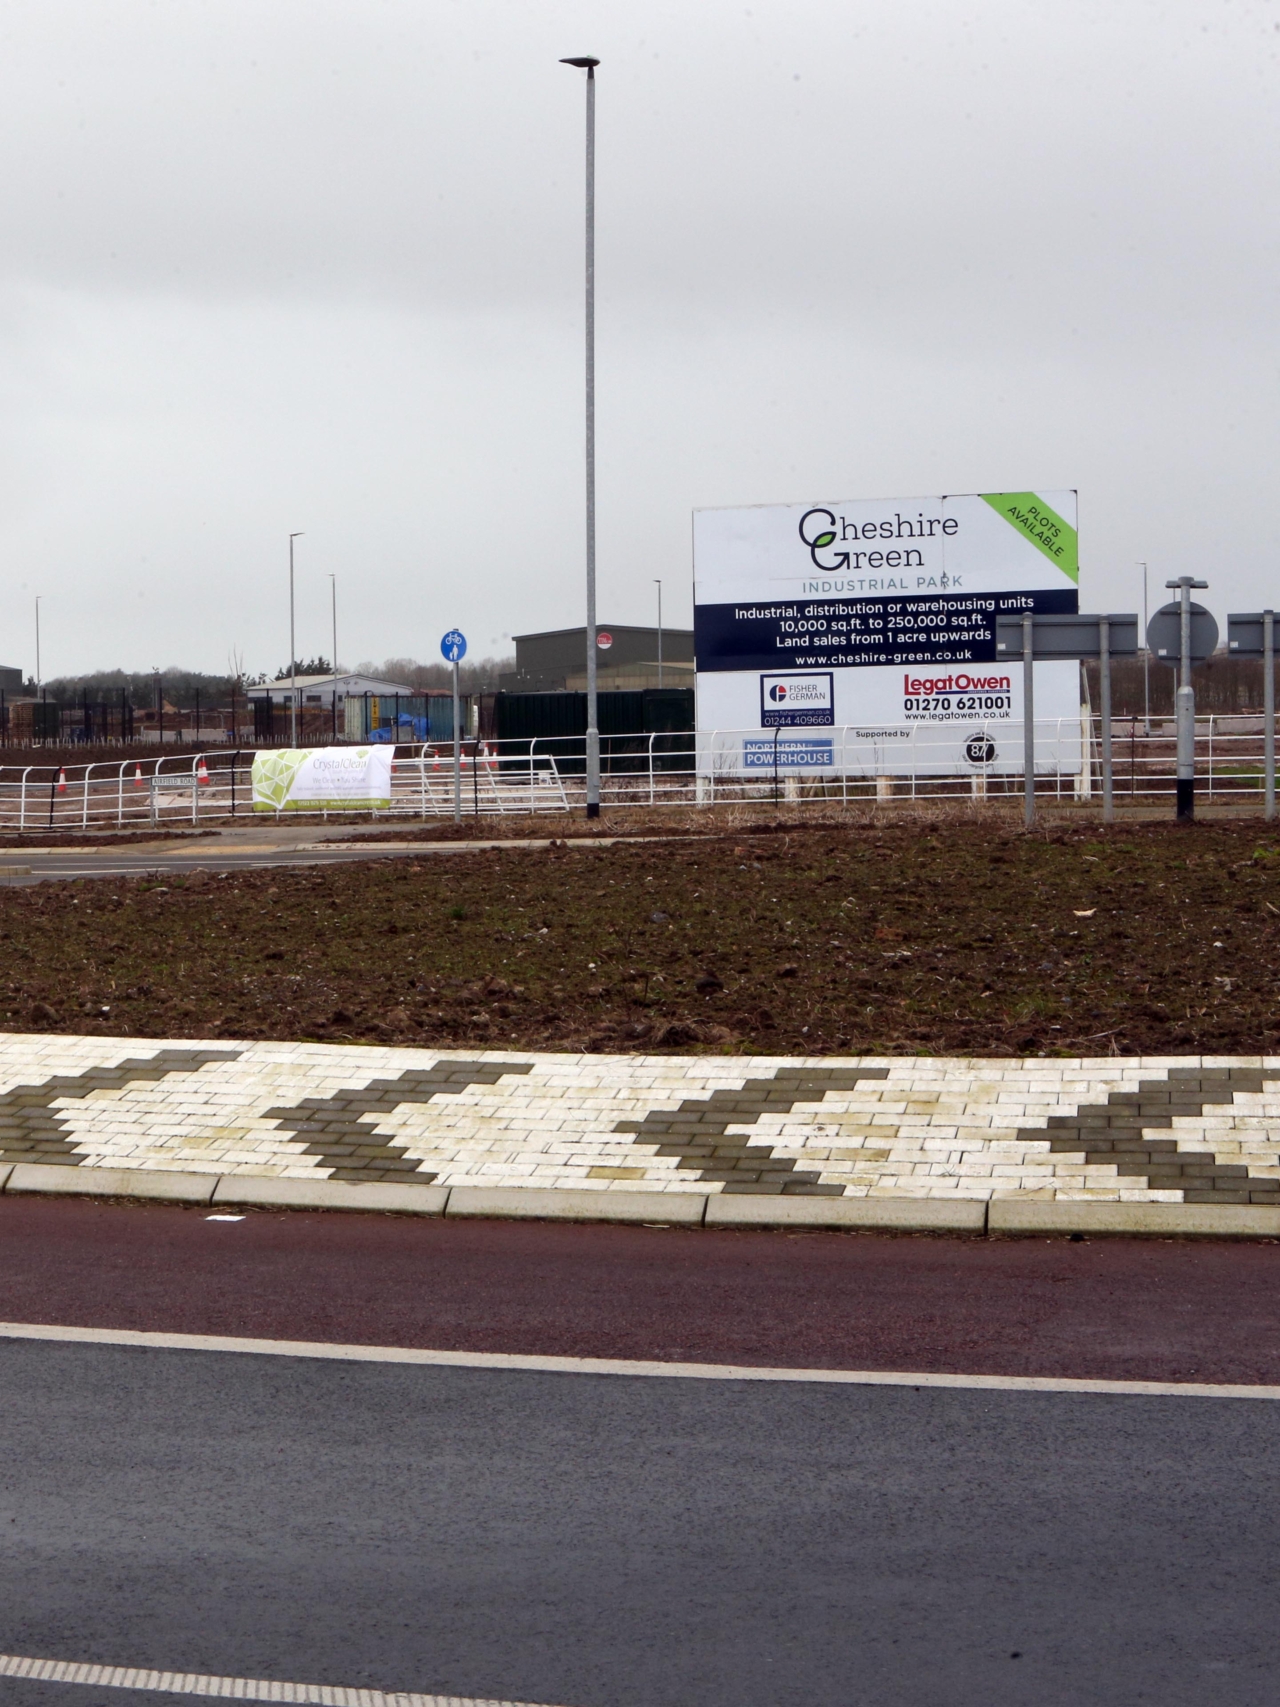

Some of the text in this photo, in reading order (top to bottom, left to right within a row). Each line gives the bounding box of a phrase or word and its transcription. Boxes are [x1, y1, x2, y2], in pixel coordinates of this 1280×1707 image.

[799, 508, 959, 548] Cheshire
[1027, 506, 1062, 538] PLOTS
[1007, 506, 1065, 557] AVAILABLE
[811, 536, 925, 571] Green
[803, 575, 963, 593] INDUSTRIAL PARK
[735, 596, 1035, 619] Industrial, distribution or warehousing units
[780, 613, 987, 634] 10,000 sq.ft. to 250,000 sq.ft.
[776, 629, 992, 648] Land sales from 1 acre upwards
[795, 649, 973, 665] www.cheshire-green.co.uk
[789, 692, 826, 701] GERMAN
[904, 696, 1011, 711] 01270 621001
[764, 715, 831, 725] 01244 409660
[905, 710, 1011, 721] www.legatowen.co.uk
[855, 730, 910, 738] Supported by
[747, 753, 830, 764] POWERHOUSE
